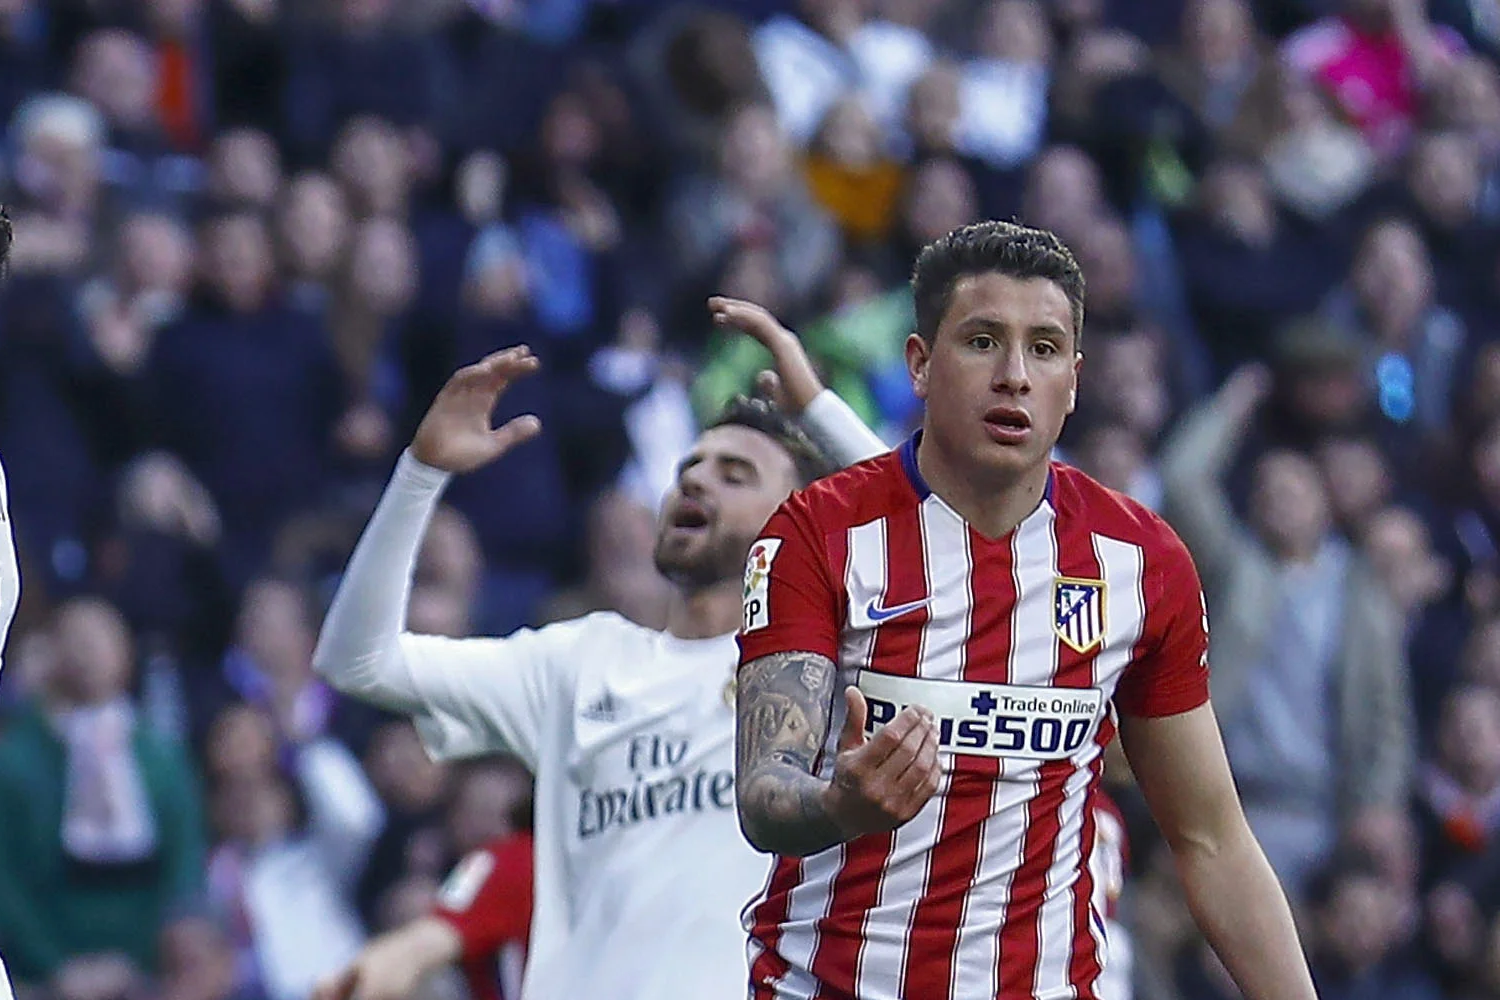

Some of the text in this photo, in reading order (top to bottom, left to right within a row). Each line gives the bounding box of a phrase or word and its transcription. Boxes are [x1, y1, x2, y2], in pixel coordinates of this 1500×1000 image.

[866, 696, 1091, 753] Ps500
[1001, 695, 1097, 715] Trade Online
[627, 734, 689, 771] Fly
[578, 767, 735, 839] Emirate
